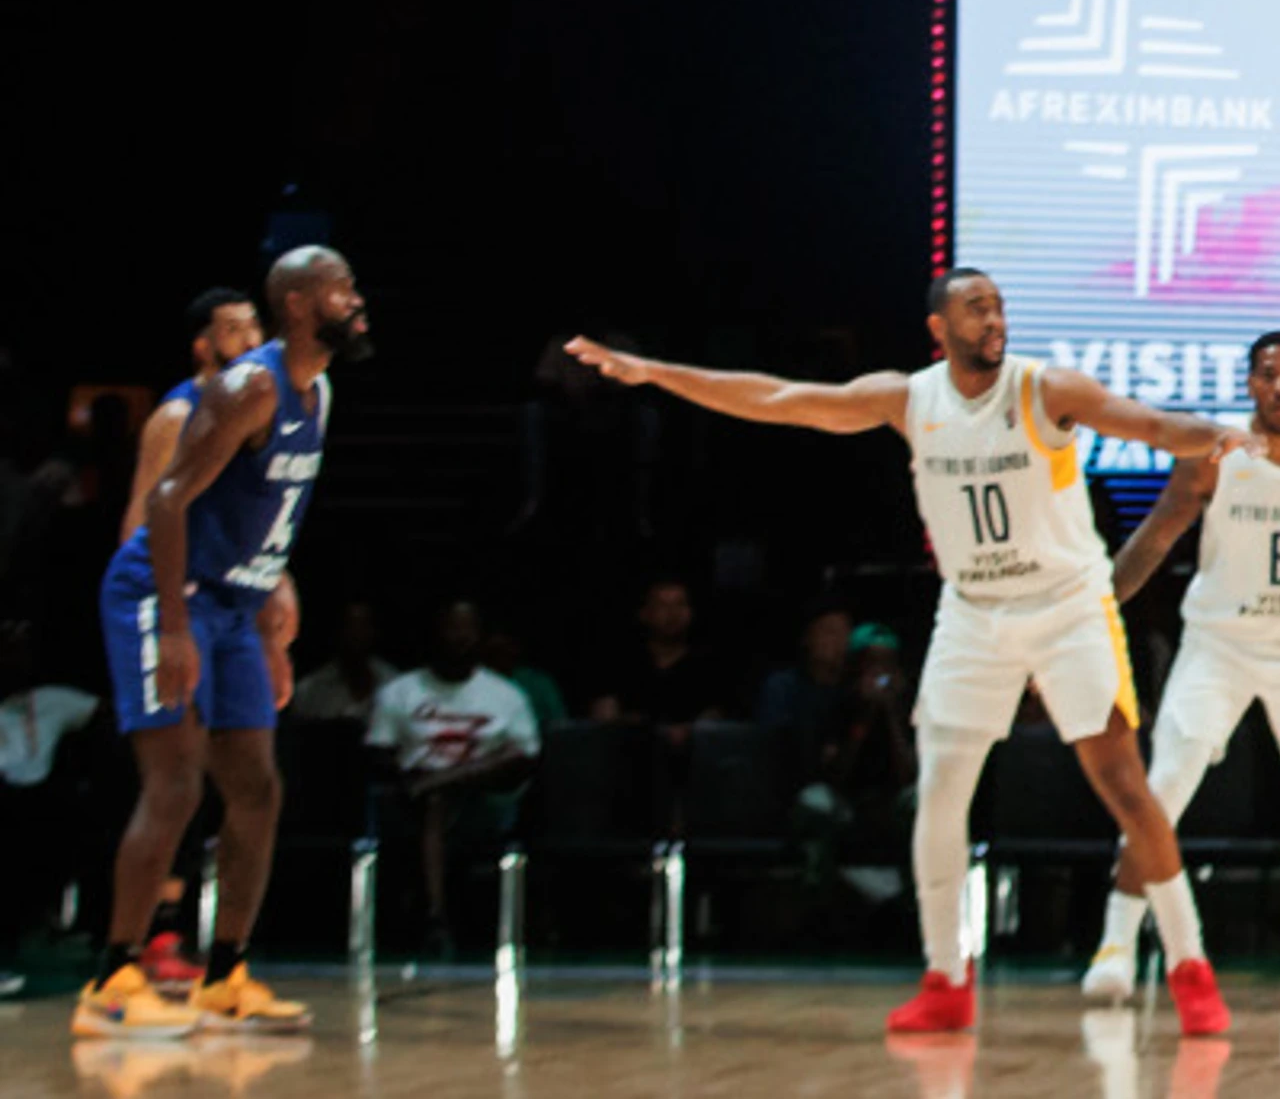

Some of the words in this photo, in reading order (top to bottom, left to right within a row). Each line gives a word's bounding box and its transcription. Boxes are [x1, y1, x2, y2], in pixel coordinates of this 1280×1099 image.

[988, 88, 1273, 131] AFREXIMBANK
[1050, 341, 1247, 401] VISIT
[960, 482, 1011, 546] 10
